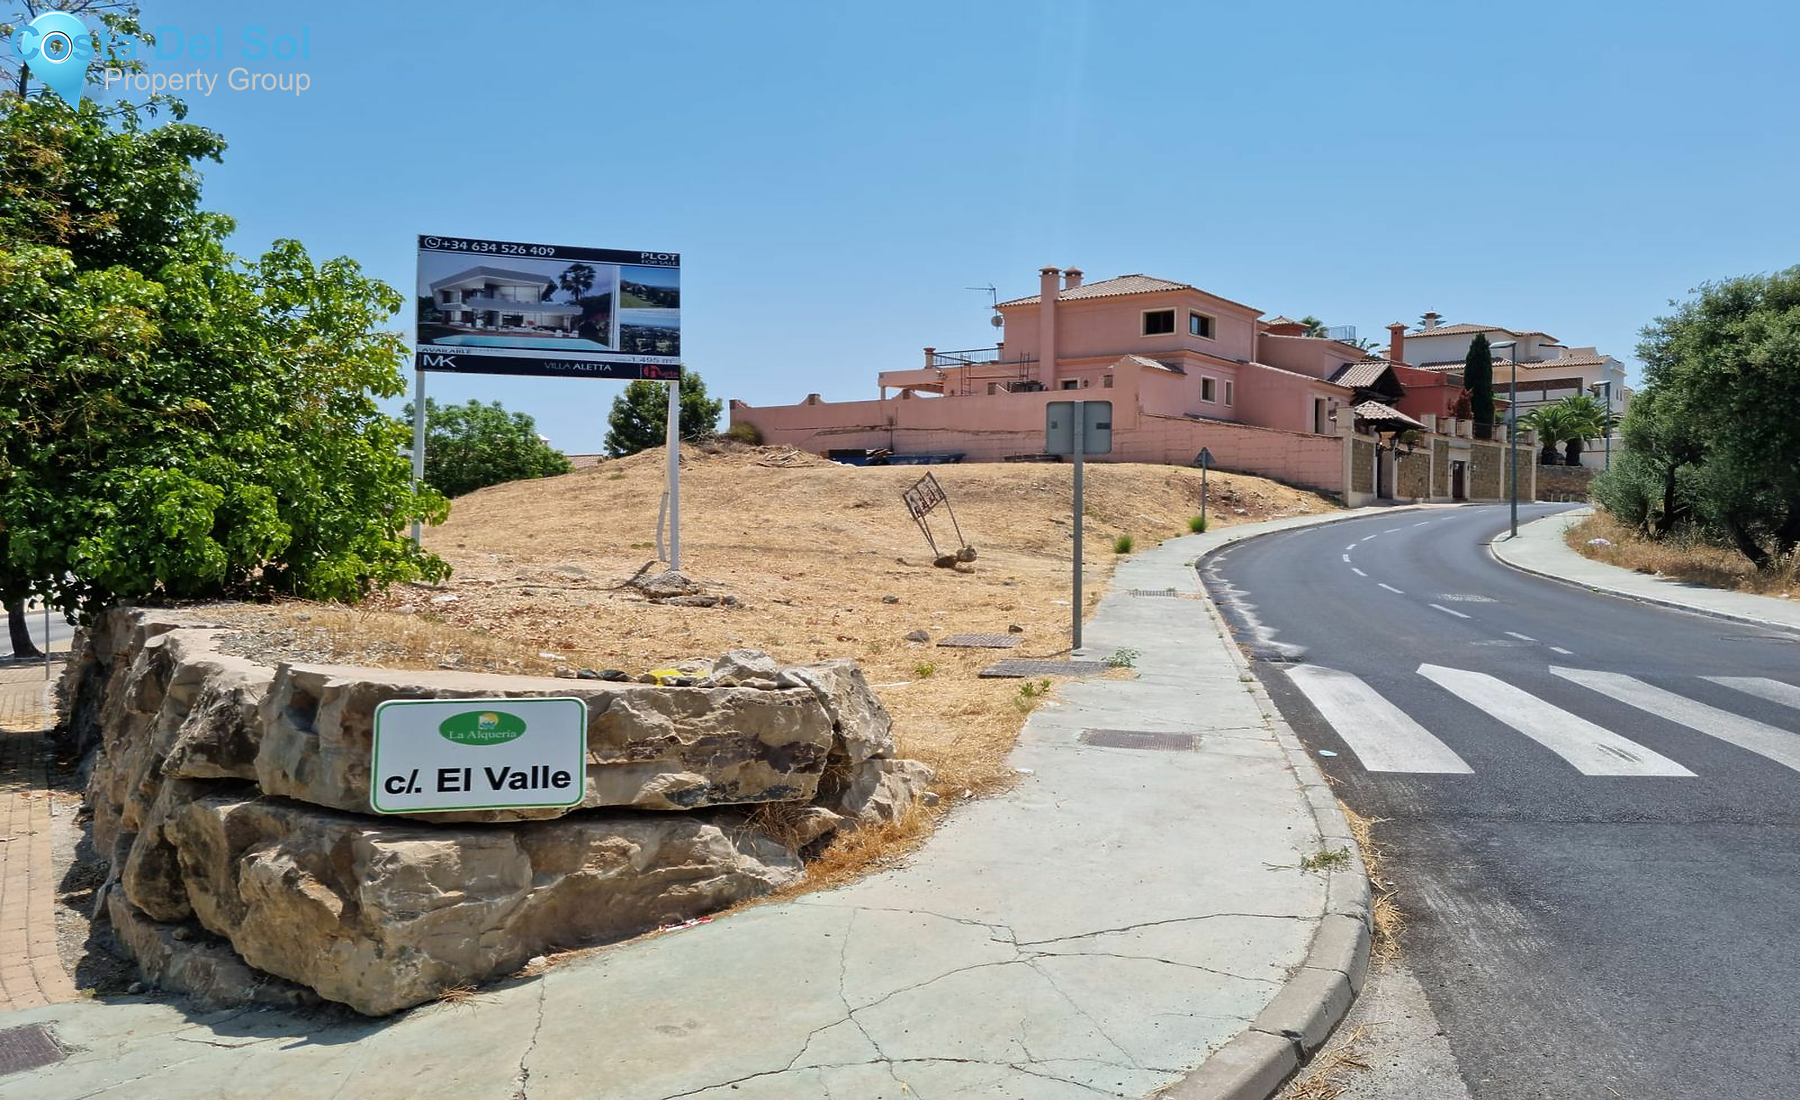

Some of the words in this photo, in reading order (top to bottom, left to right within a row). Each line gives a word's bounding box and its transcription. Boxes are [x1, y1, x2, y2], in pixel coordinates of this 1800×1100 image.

[441, 240, 468, 250] +34
[471, 242, 497, 252] 634
[501, 244, 526, 254] 526
[530, 246, 555, 256] 409
[641, 252, 677, 261] PLOT
[423, 354, 457, 368] MK
[544, 361, 572, 370] VILLA
[572, 363, 612, 372] ALETTA
[449, 730, 464, 740] La
[384, 768, 422, 795] c/.
[436, 767, 472, 793] El
[484, 765, 572, 791] Valle
